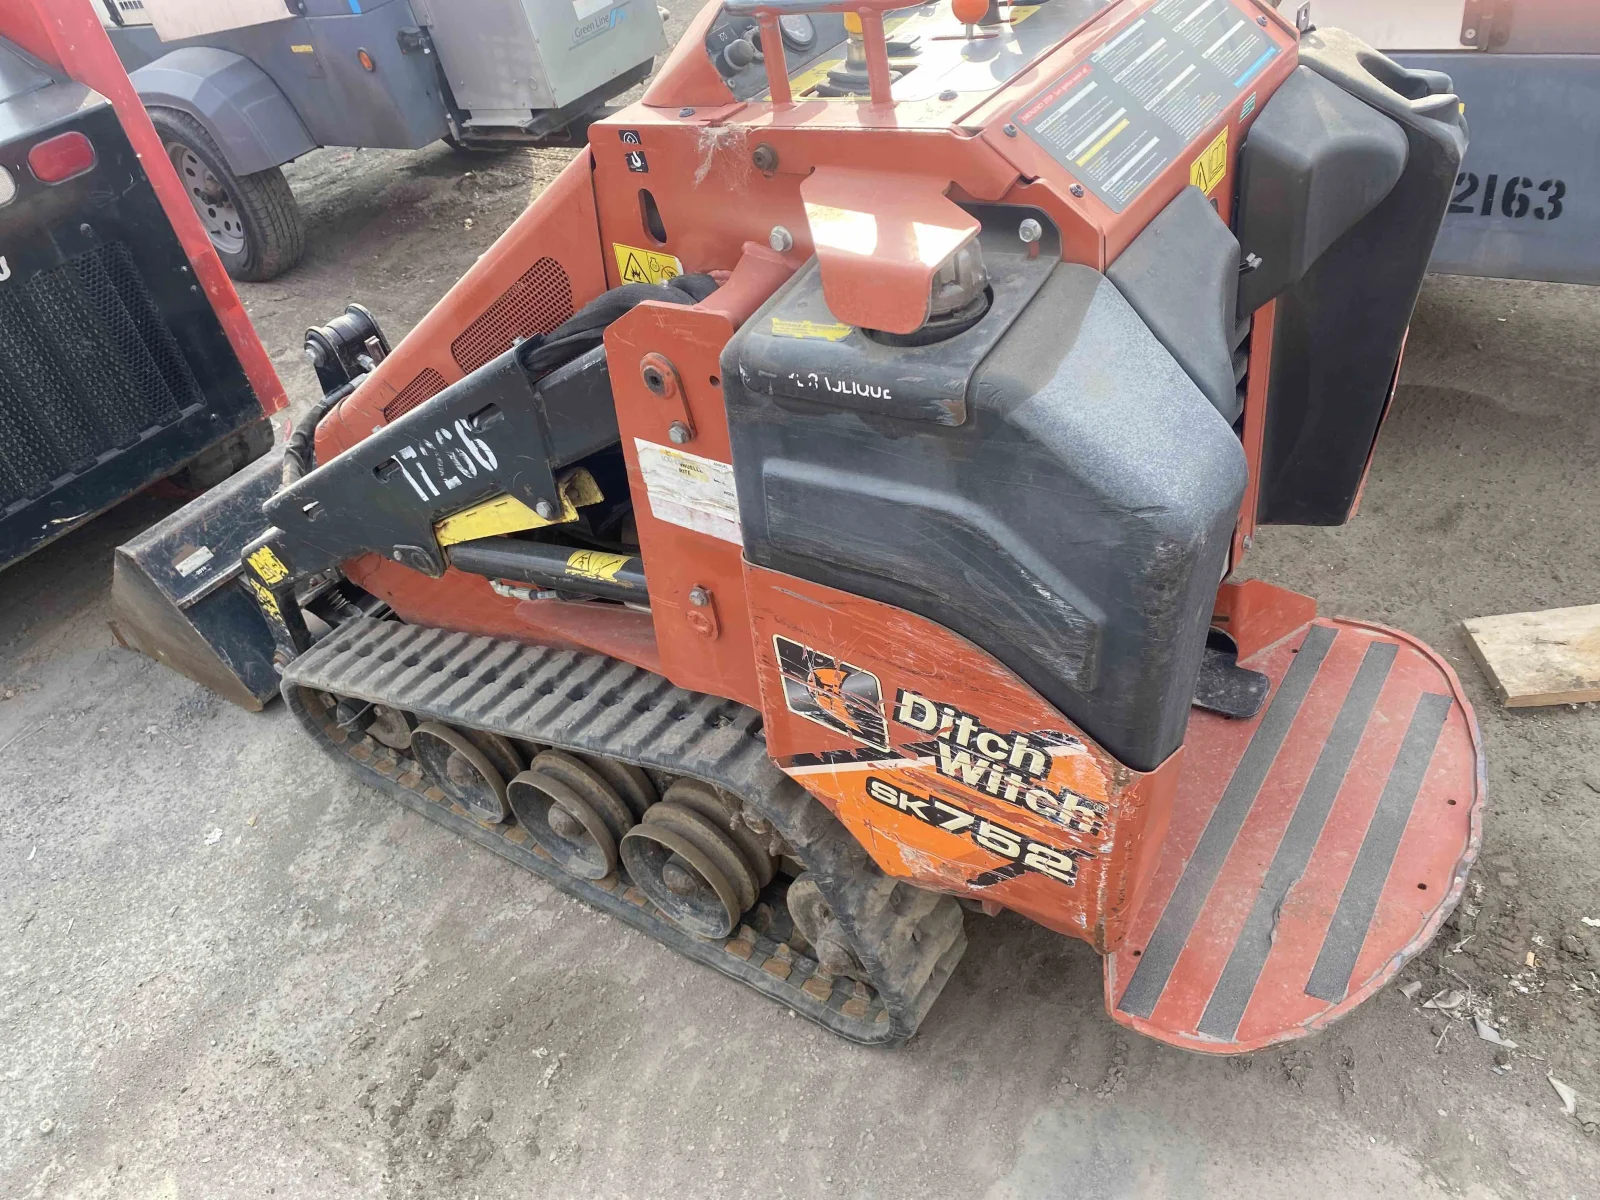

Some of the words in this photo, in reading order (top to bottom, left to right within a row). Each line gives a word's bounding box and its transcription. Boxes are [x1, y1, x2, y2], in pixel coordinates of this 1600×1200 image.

[574, 23, 595, 38] Green
[595, 15, 609, 27] Line
[1448, 172, 1566, 220] 2163
[899, 690, 1048, 777] Ditch
[938, 743, 1099, 834] Witch
[870, 780, 1077, 887] SK752
